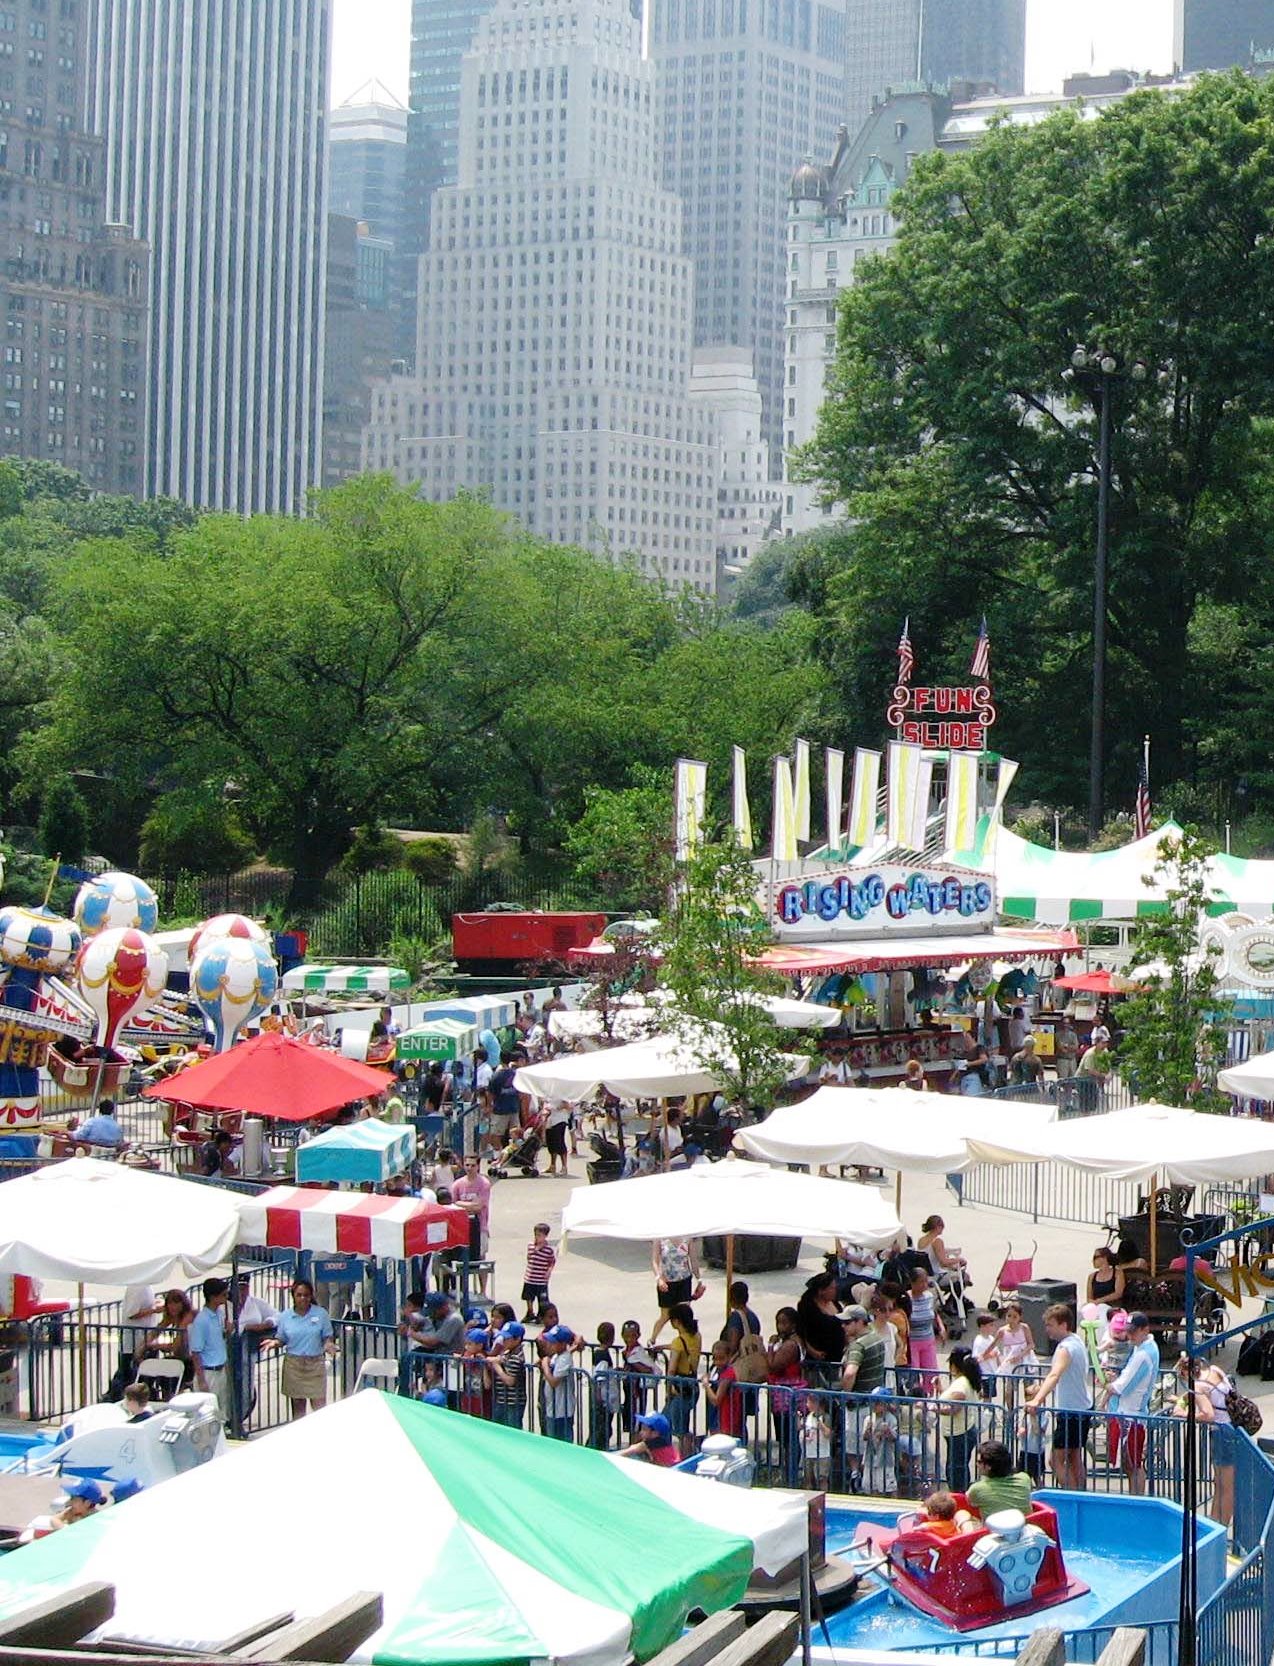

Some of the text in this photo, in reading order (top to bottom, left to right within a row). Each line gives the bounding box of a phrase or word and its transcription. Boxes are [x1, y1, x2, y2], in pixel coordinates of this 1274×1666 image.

[914, 687, 973, 713] FUN
[902, 722, 984, 748] SLIDE
[779, 873, 991, 922] RISING WATERS
[400, 1035, 449, 1051] ENTER
[119, 1438, 137, 1465] 4
[927, 1547, 940, 1574] 7
